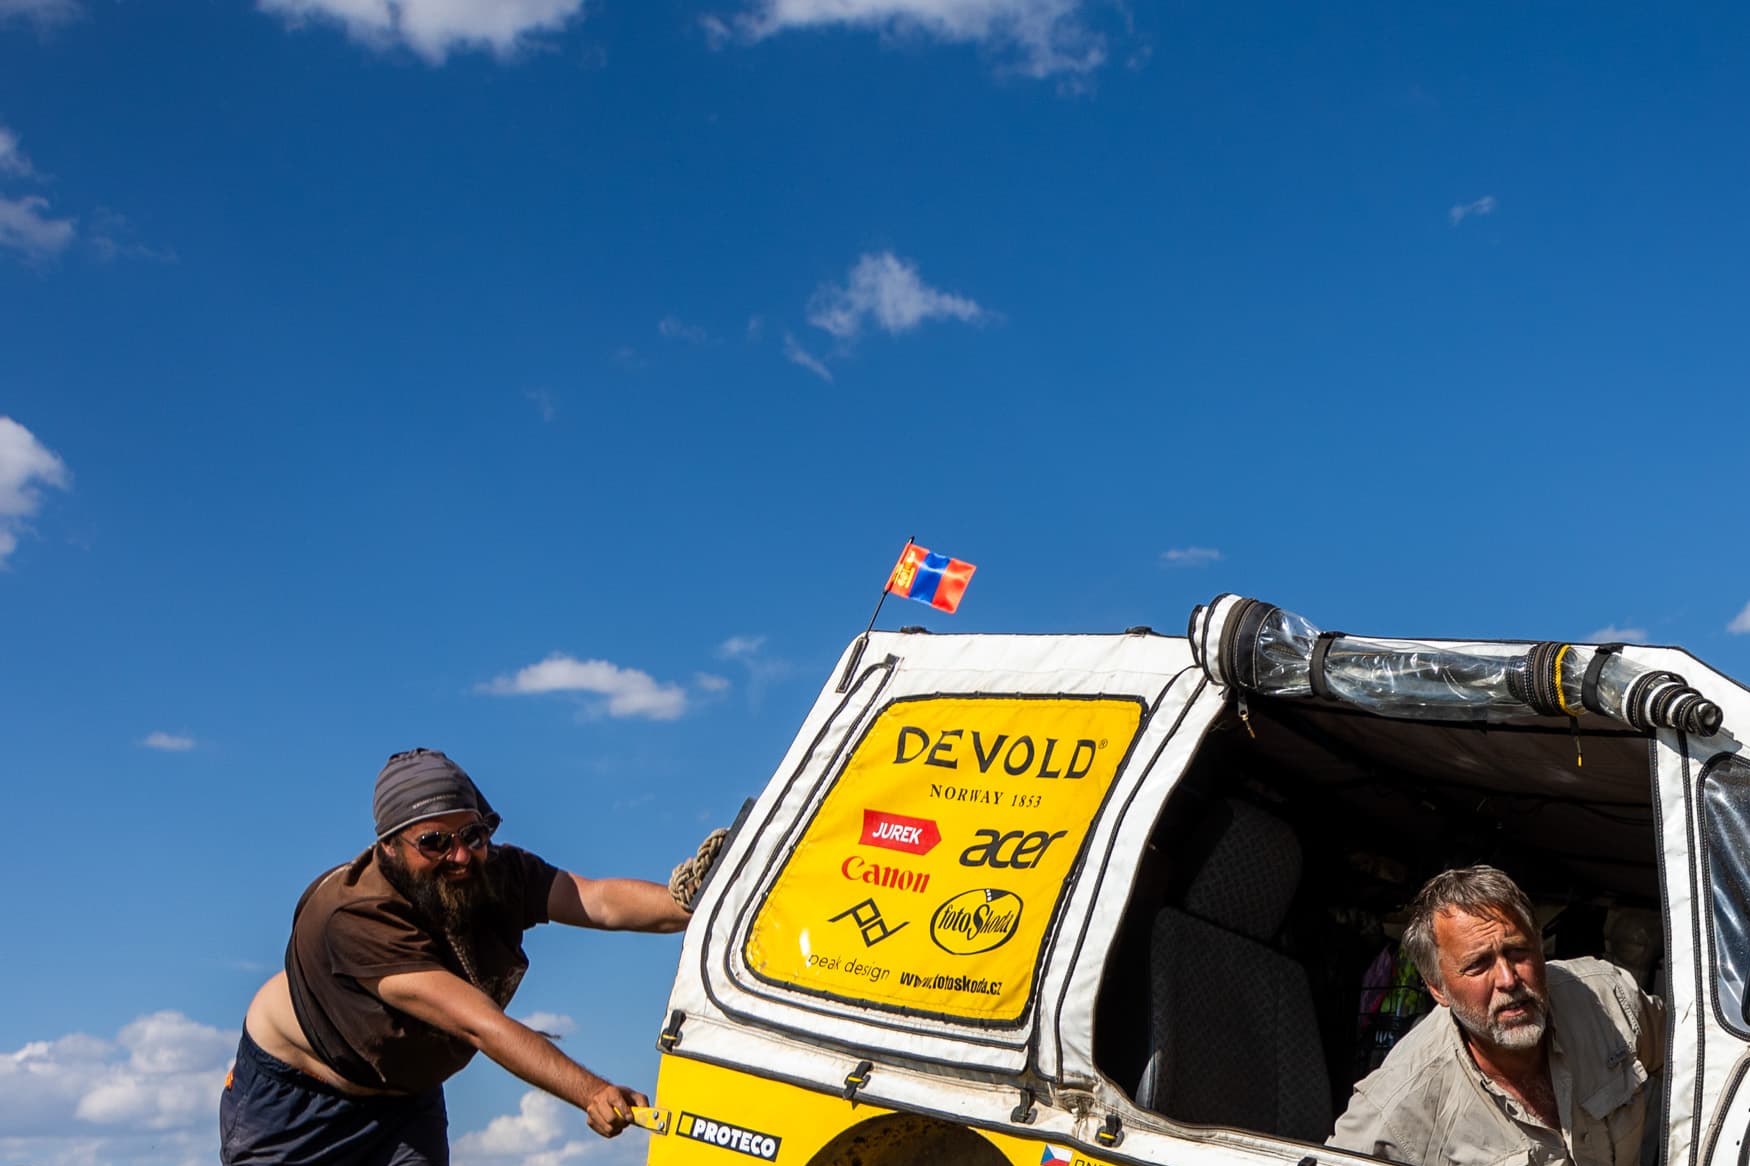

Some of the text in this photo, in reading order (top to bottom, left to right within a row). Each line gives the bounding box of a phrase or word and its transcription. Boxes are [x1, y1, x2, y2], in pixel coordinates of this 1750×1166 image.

[893, 726, 1096, 779] DEVOLD
[929, 783, 1043, 809] NORWAY 1853
[871, 821, 924, 845] JUREK
[959, 828, 1068, 869] acer
[841, 856, 931, 893] Canon
[844, 957, 891, 983] design
[692, 1117, 777, 1159] PROTECO
